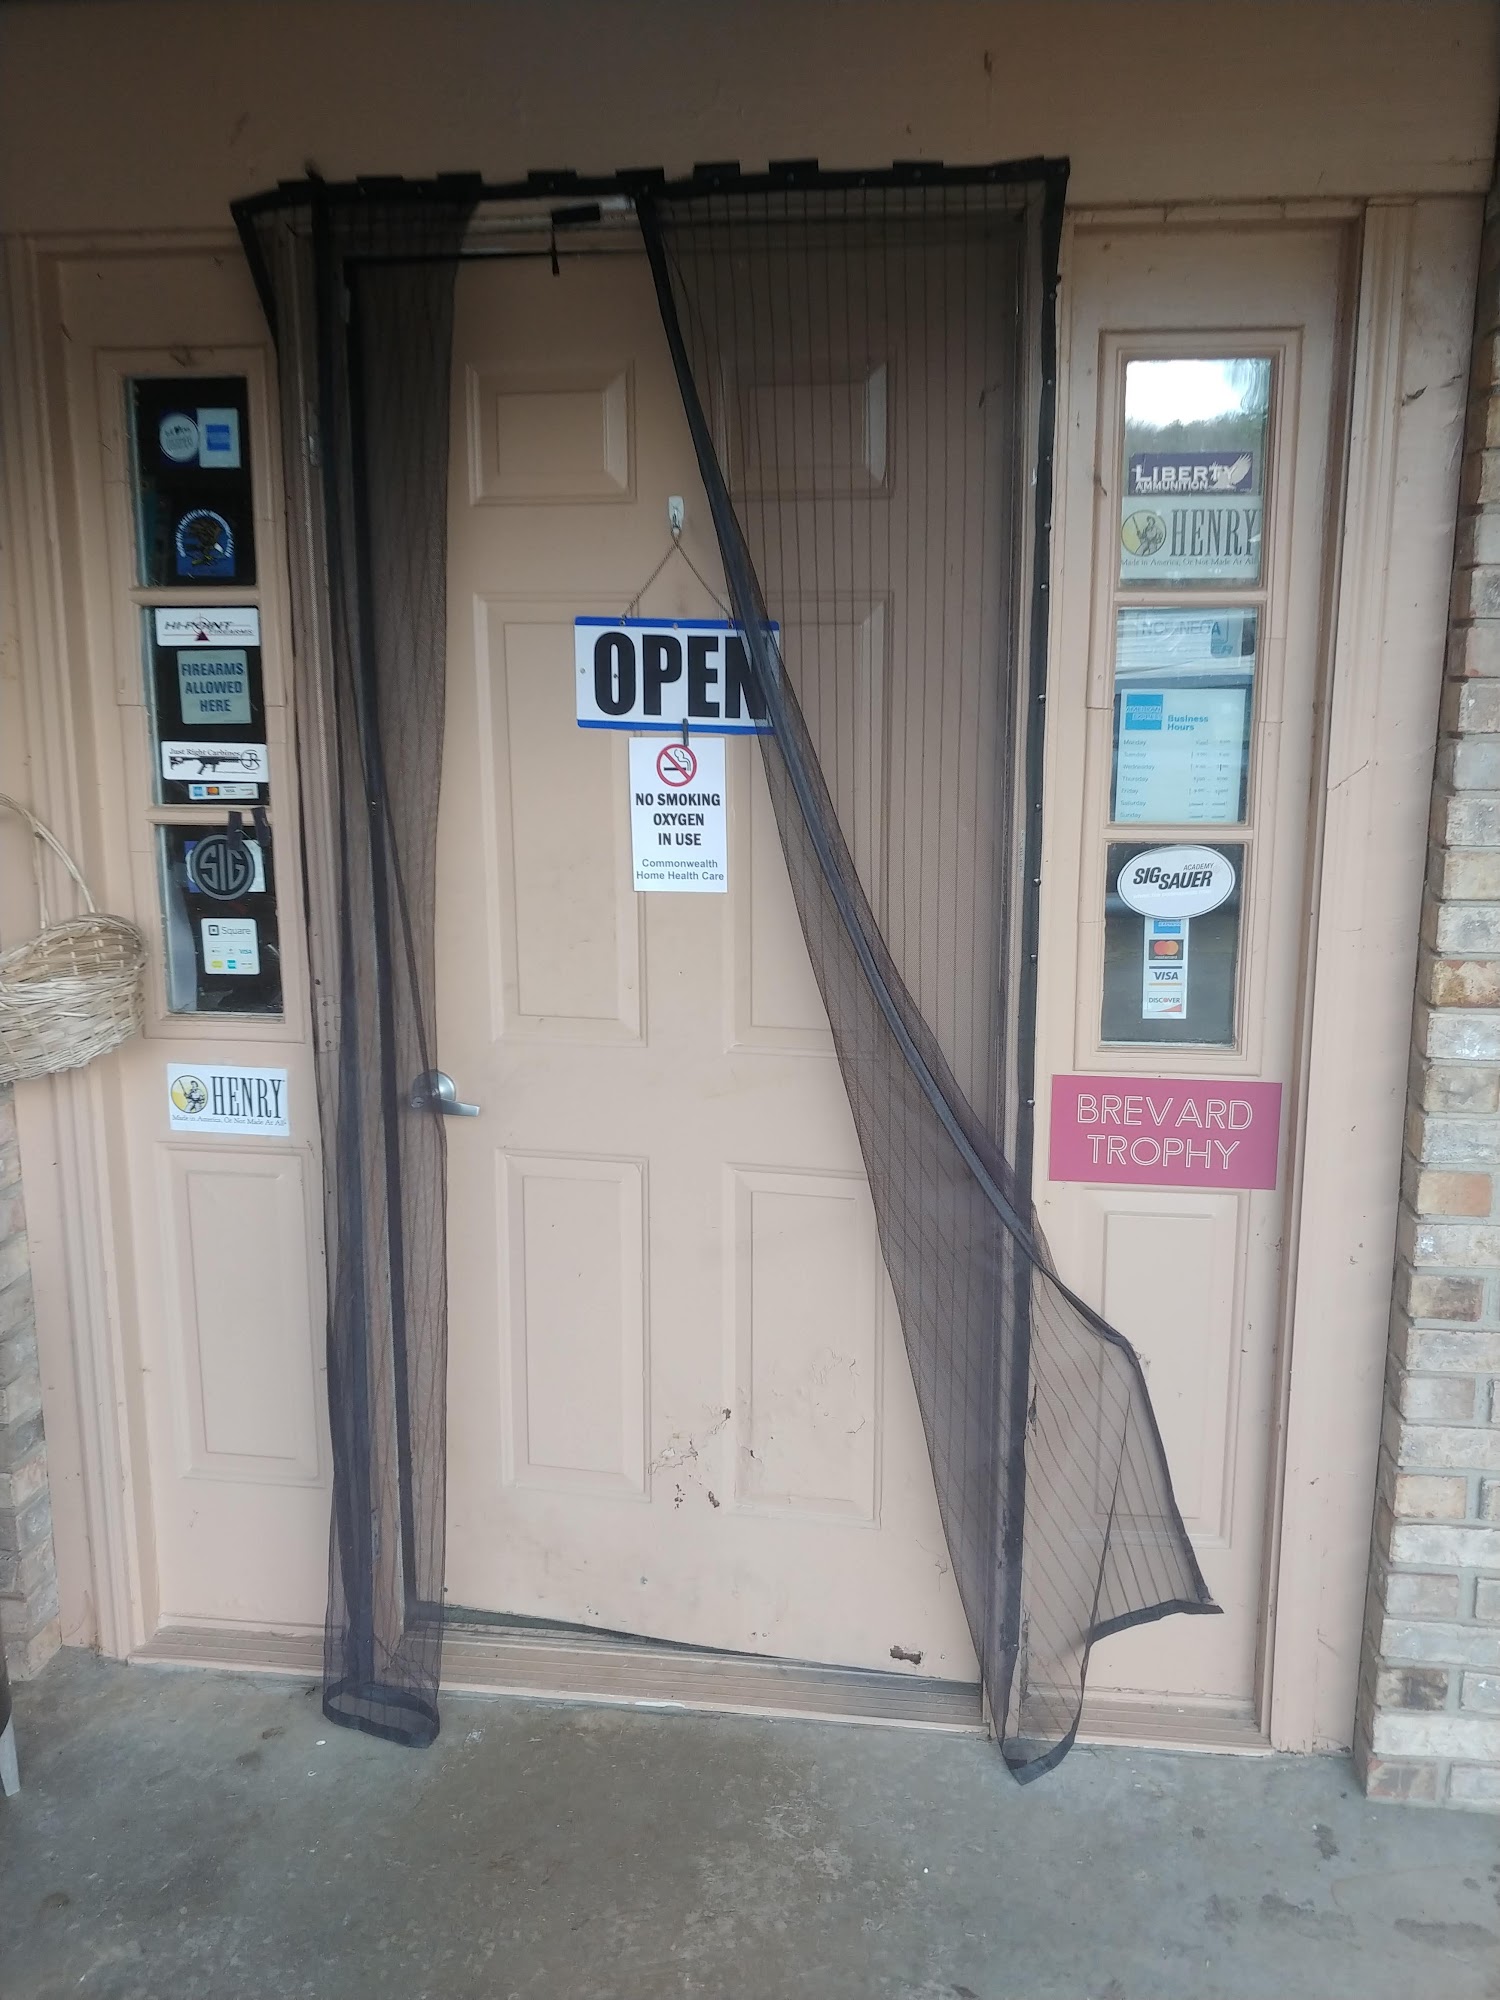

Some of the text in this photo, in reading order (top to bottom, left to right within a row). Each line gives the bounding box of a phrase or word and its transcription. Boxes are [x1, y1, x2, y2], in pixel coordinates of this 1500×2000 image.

[1131, 463, 1233, 482] LIBERTY
[1135, 480, 1209, 491] AMMUNITION
[1170, 509, 1259, 557] HENRY
[181, 662, 244, 677] FIREARMS
[594, 631, 767, 720] OPEN
[185, 681, 243, 695] ALLOWED
[200, 699, 231, 712] HERE
[1167, 715, 1208, 723] Business
[1123, 739, 1147, 747] Monday
[186, 748, 206, 757] Right
[635, 792, 721, 806] NO SMOKING
[653, 812, 705, 826] OXYGEN
[658, 832, 702, 846] IN USE
[200, 843, 246, 891] SIG
[642, 858, 718, 868] Commonwealth
[1183, 863, 1214, 871] ACADEMY
[636, 870, 724, 881] Home Health Care
[1133, 867, 1213, 890] SIG SAUER
[221, 926, 251, 936] Square
[1153, 971, 1179, 980] VISA
[210, 1076, 282, 1118] HENRY
[1077, 1093, 1253, 1130] BREVARD
[1087, 1134, 1240, 1170] TROPHY
